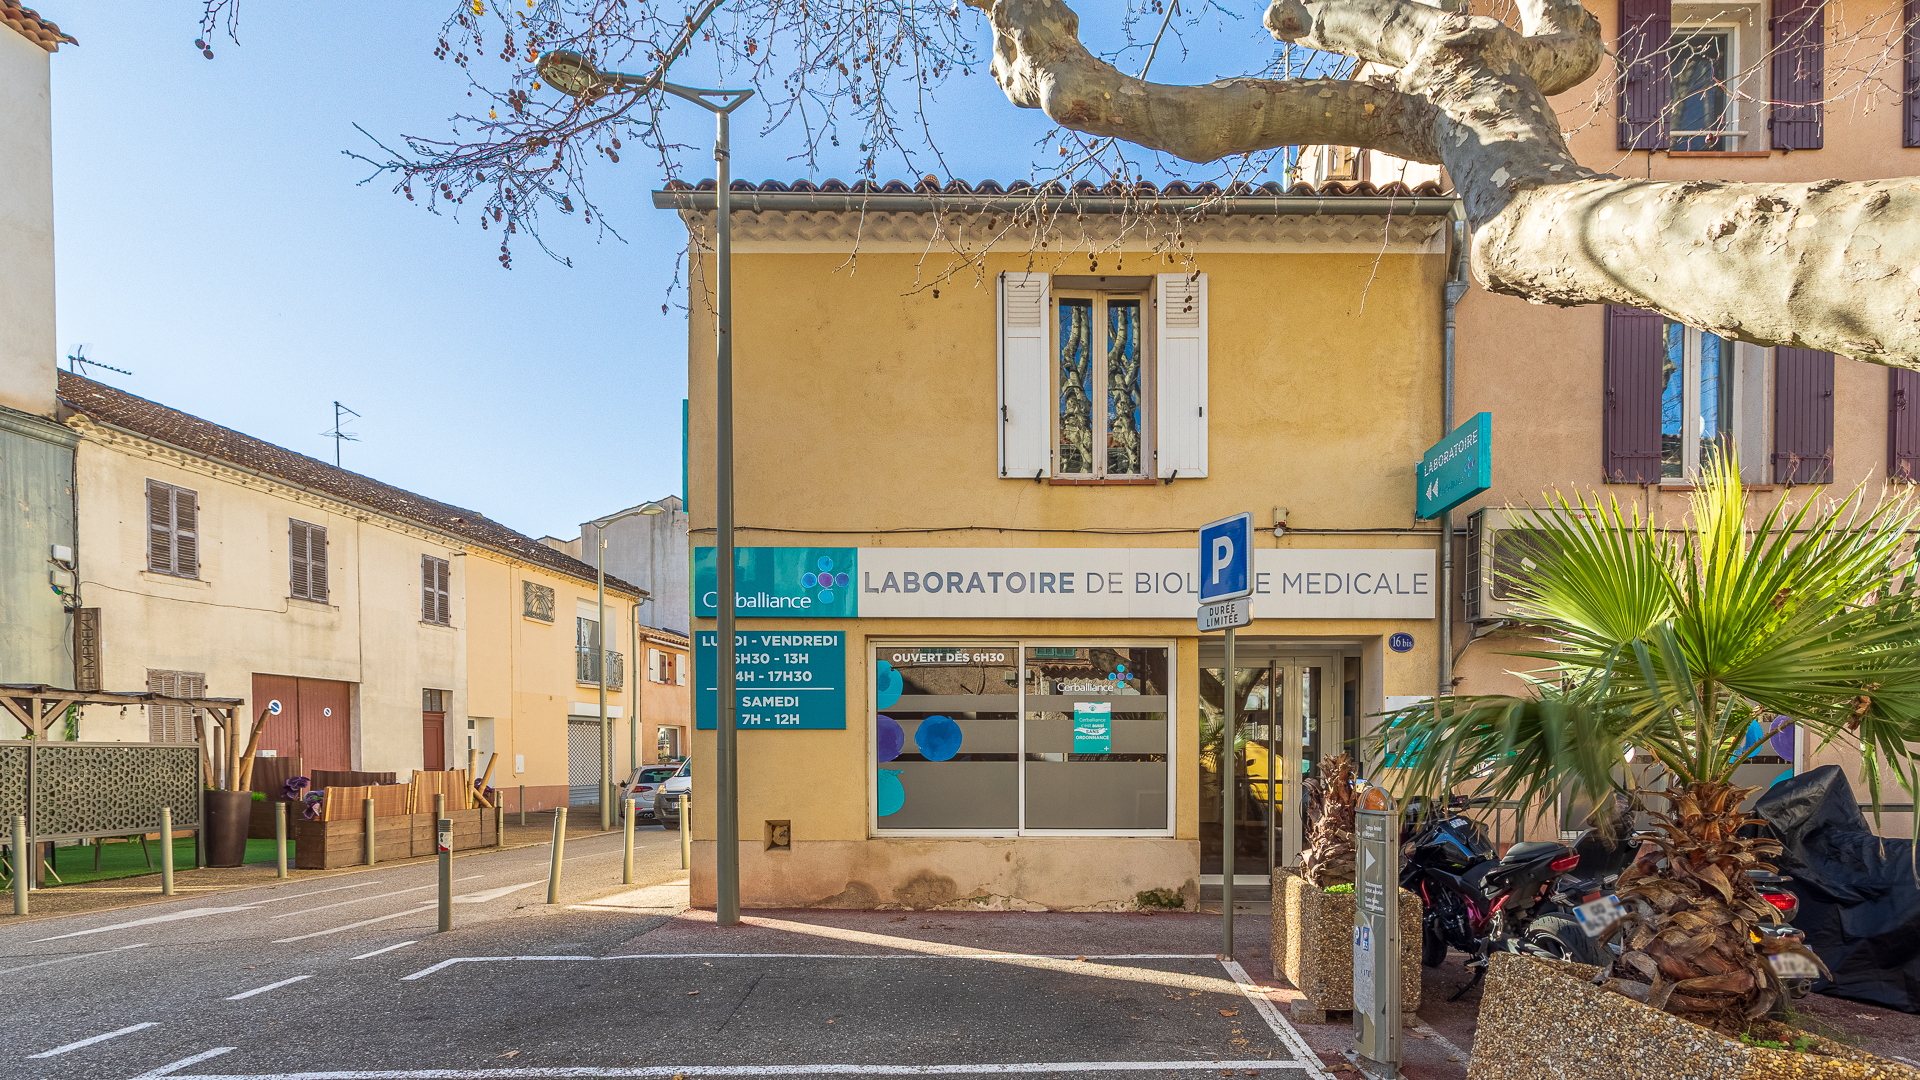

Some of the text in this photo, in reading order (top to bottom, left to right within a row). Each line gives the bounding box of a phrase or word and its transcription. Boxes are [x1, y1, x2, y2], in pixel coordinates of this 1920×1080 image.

[1424, 429, 1478, 477] LABORATOIRE
[1212, 535, 1234, 585] P
[864, 571, 1428, 594] LABORATOIRE DE BIOLE MEDICALE
[702, 591, 812, 609] Cballiance
[1209, 602, 1236, 616] DURÉE
[1206, 611, 1239, 627] LIMITÉE
[702, 635, 747, 647] LUDI
[761, 635, 838, 647] VENDREDI
[1392, 635, 1413, 648] 16 bis
[783, 653, 809, 664] 13H
[892, 650, 1005, 663] OUVERT DÈS 6H30
[735, 671, 755, 682] 4H
[768, 671, 813, 682] 17H30
[1057, 682, 1114, 692] Cerballiance
[742, 696, 799, 707] SAMEDI
[741, 714, 761, 725] 7H
[774, 714, 800, 725] 12H
